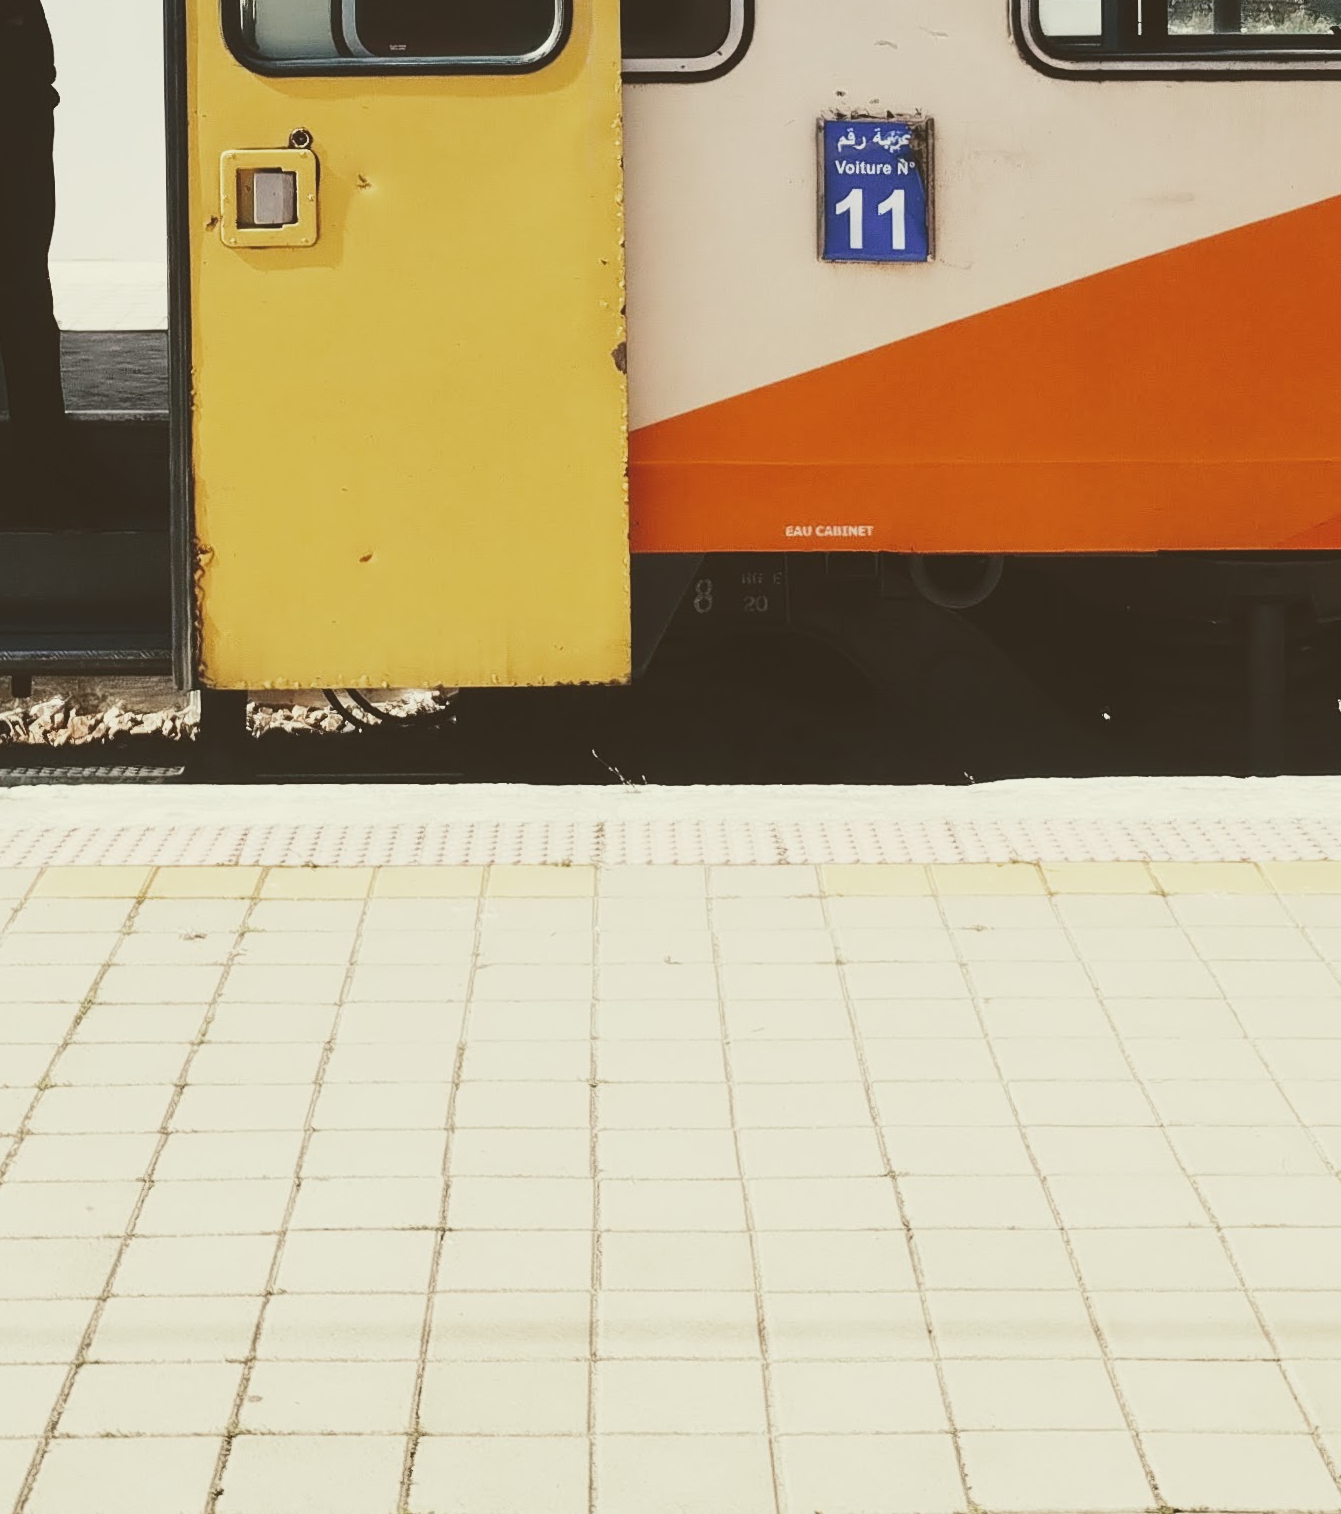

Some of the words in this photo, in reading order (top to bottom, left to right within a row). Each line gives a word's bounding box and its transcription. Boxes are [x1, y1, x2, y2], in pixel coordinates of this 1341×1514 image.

[837, 127, 867, 153] رقم
[835, 160, 892, 175] Voiture
[835, 188, 906, 250] 11
[785, 525, 812, 537] EAU
[815, 525, 874, 537] CABINET
[743, 595, 769, 613] 20
